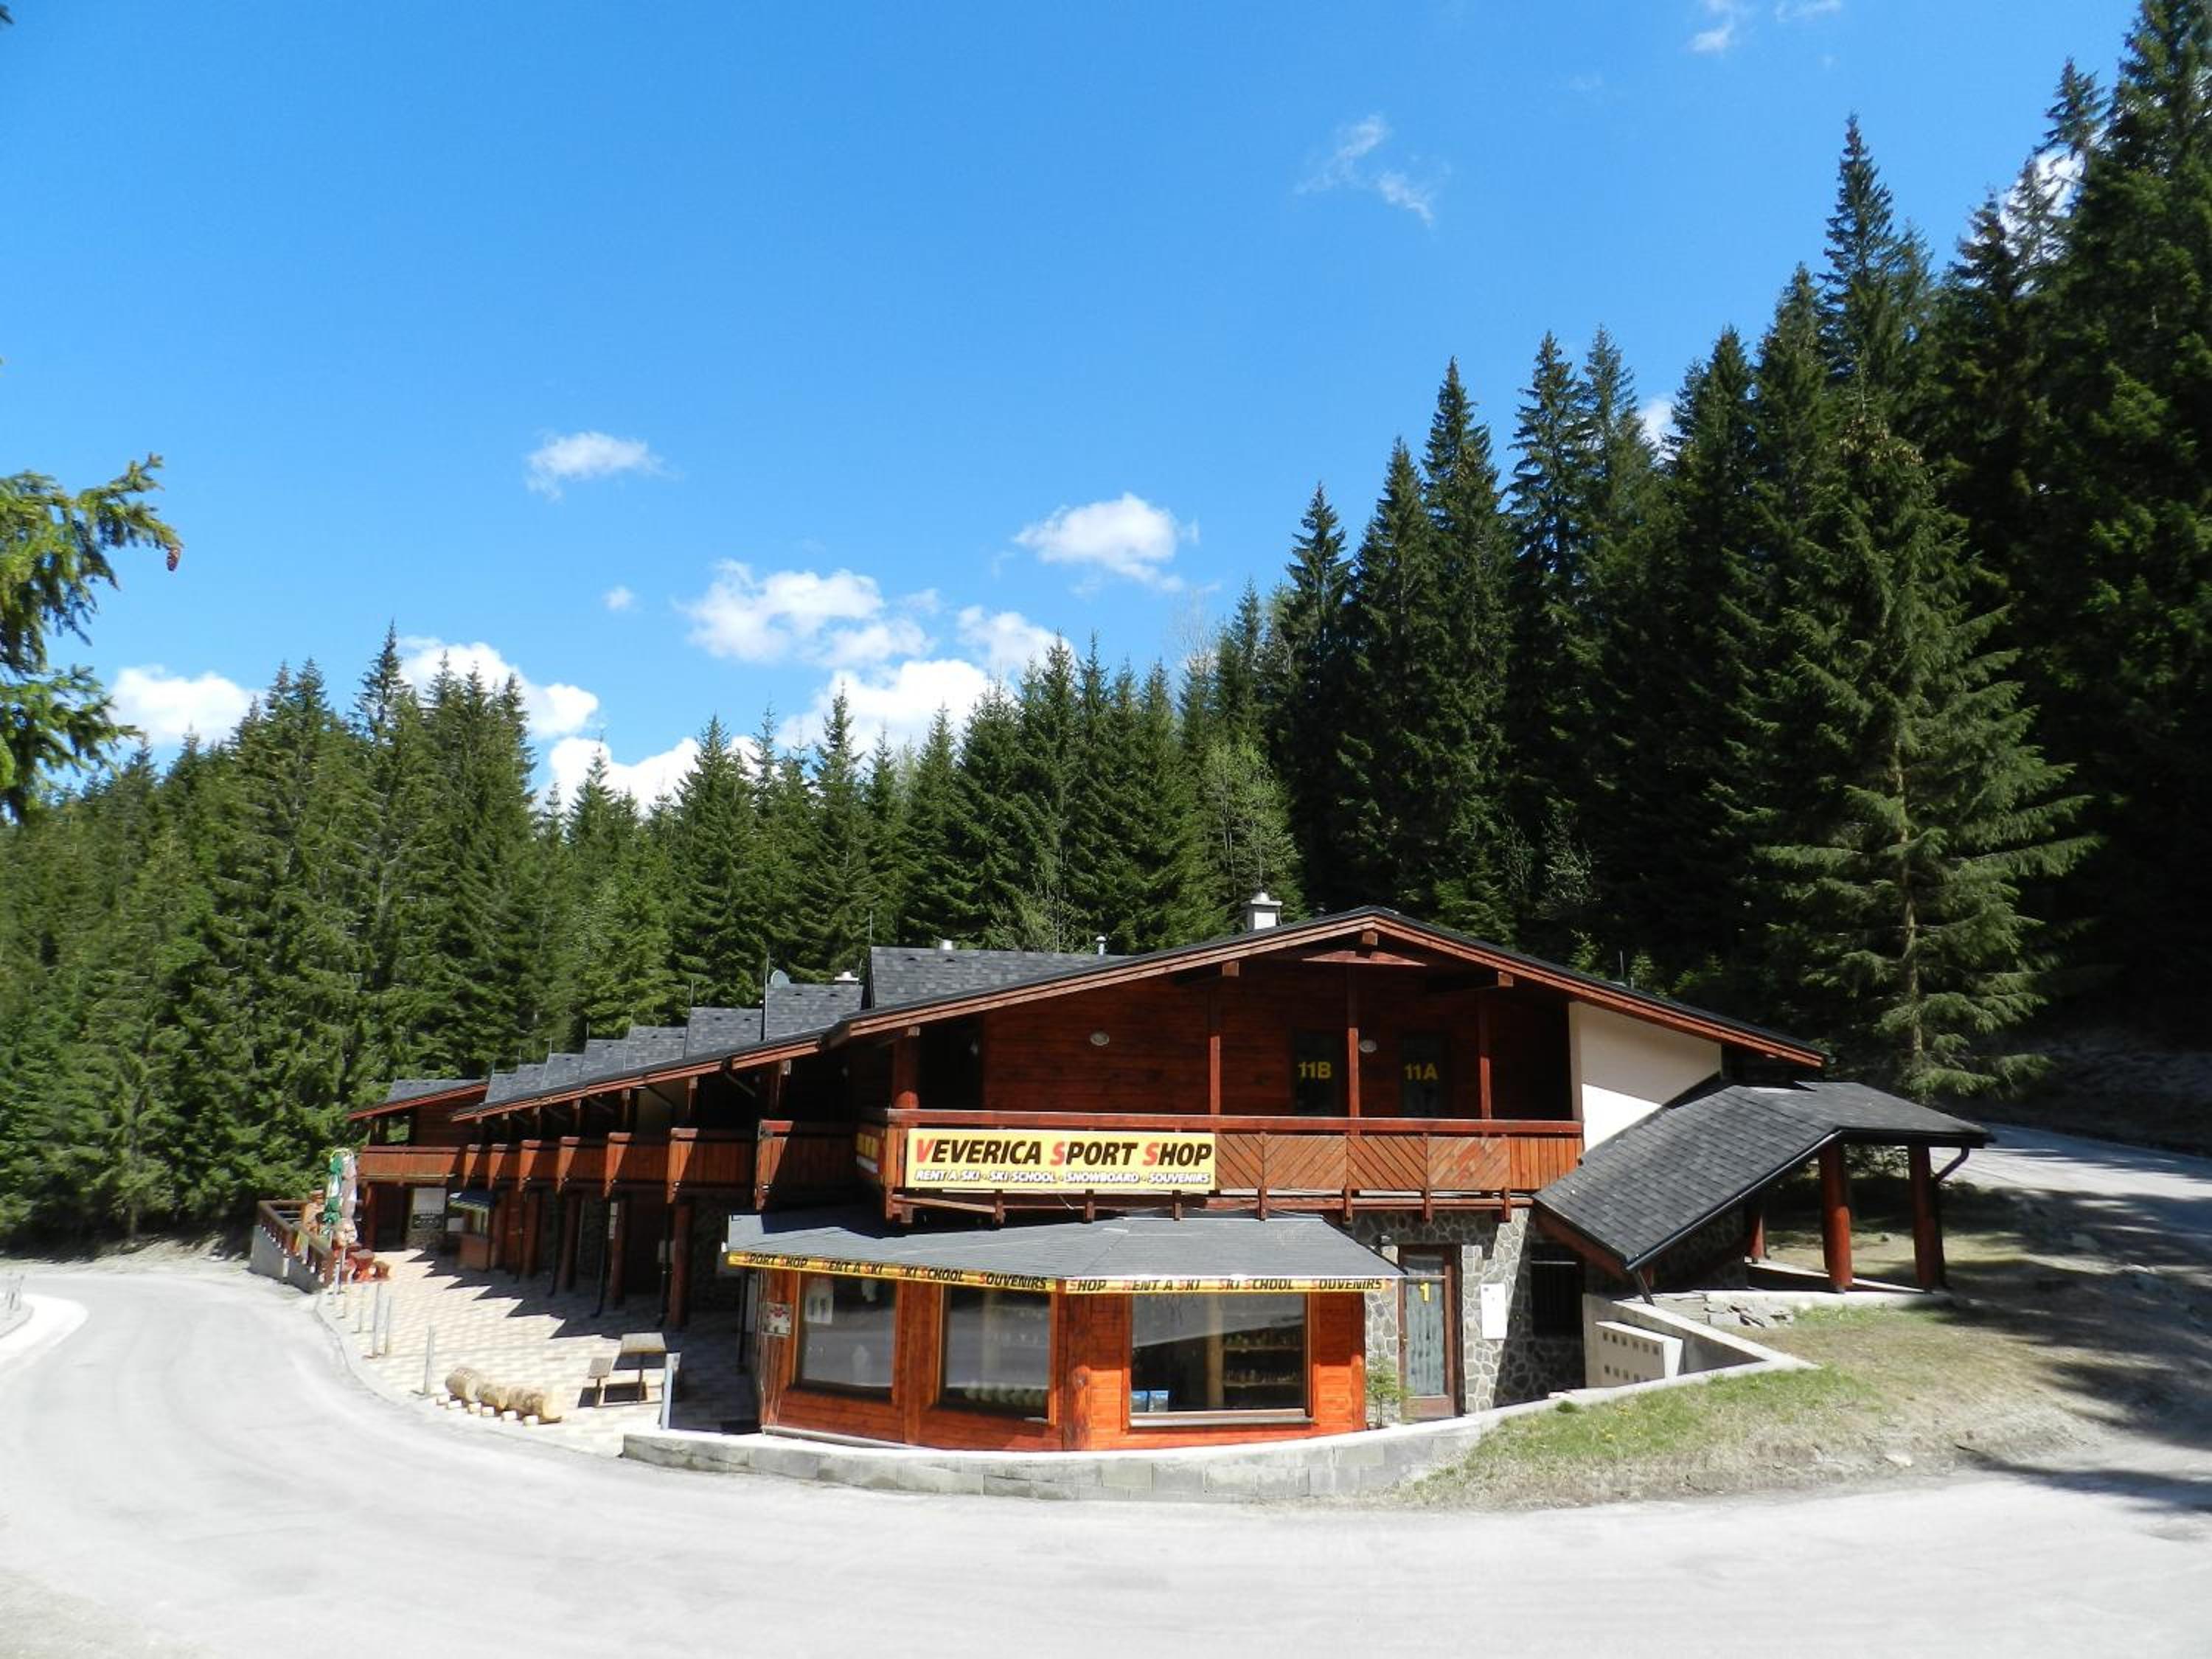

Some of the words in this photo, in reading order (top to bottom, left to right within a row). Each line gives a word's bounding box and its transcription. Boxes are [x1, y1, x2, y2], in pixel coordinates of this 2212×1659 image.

[1298, 1061, 1332, 1079] 11B
[1405, 1062, 1438, 1080] 11A
[917, 1138, 1042, 1165] VEVERICA
[1050, 1141, 1138, 1166] SPORT
[1143, 1142, 1213, 1166] SHOP
[915, 1169, 946, 1181] RENT
[947, 1170, 957, 1181] A
[959, 1170, 981, 1181] SKI
[989, 1171, 1009, 1181] SKI
[1012, 1171, 1057, 1183] SCHOOL
[1065, 1172, 1140, 1183] SNOWBOARD
[1149, 1172, 1210, 1184] SOUVENIRS
[921, 1265, 964, 1282] SCHOOL
[979, 1271, 1048, 1290] SOUVENIRS
[1068, 1279, 1107, 1291] SHOP
[1164, 1280, 1173, 1291] A
[1244, 1279, 1294, 1290] SCHOOL
[1310, 1279, 1382, 1290] SOUVENIRS
[1419, 1281, 1429, 1302] 1
